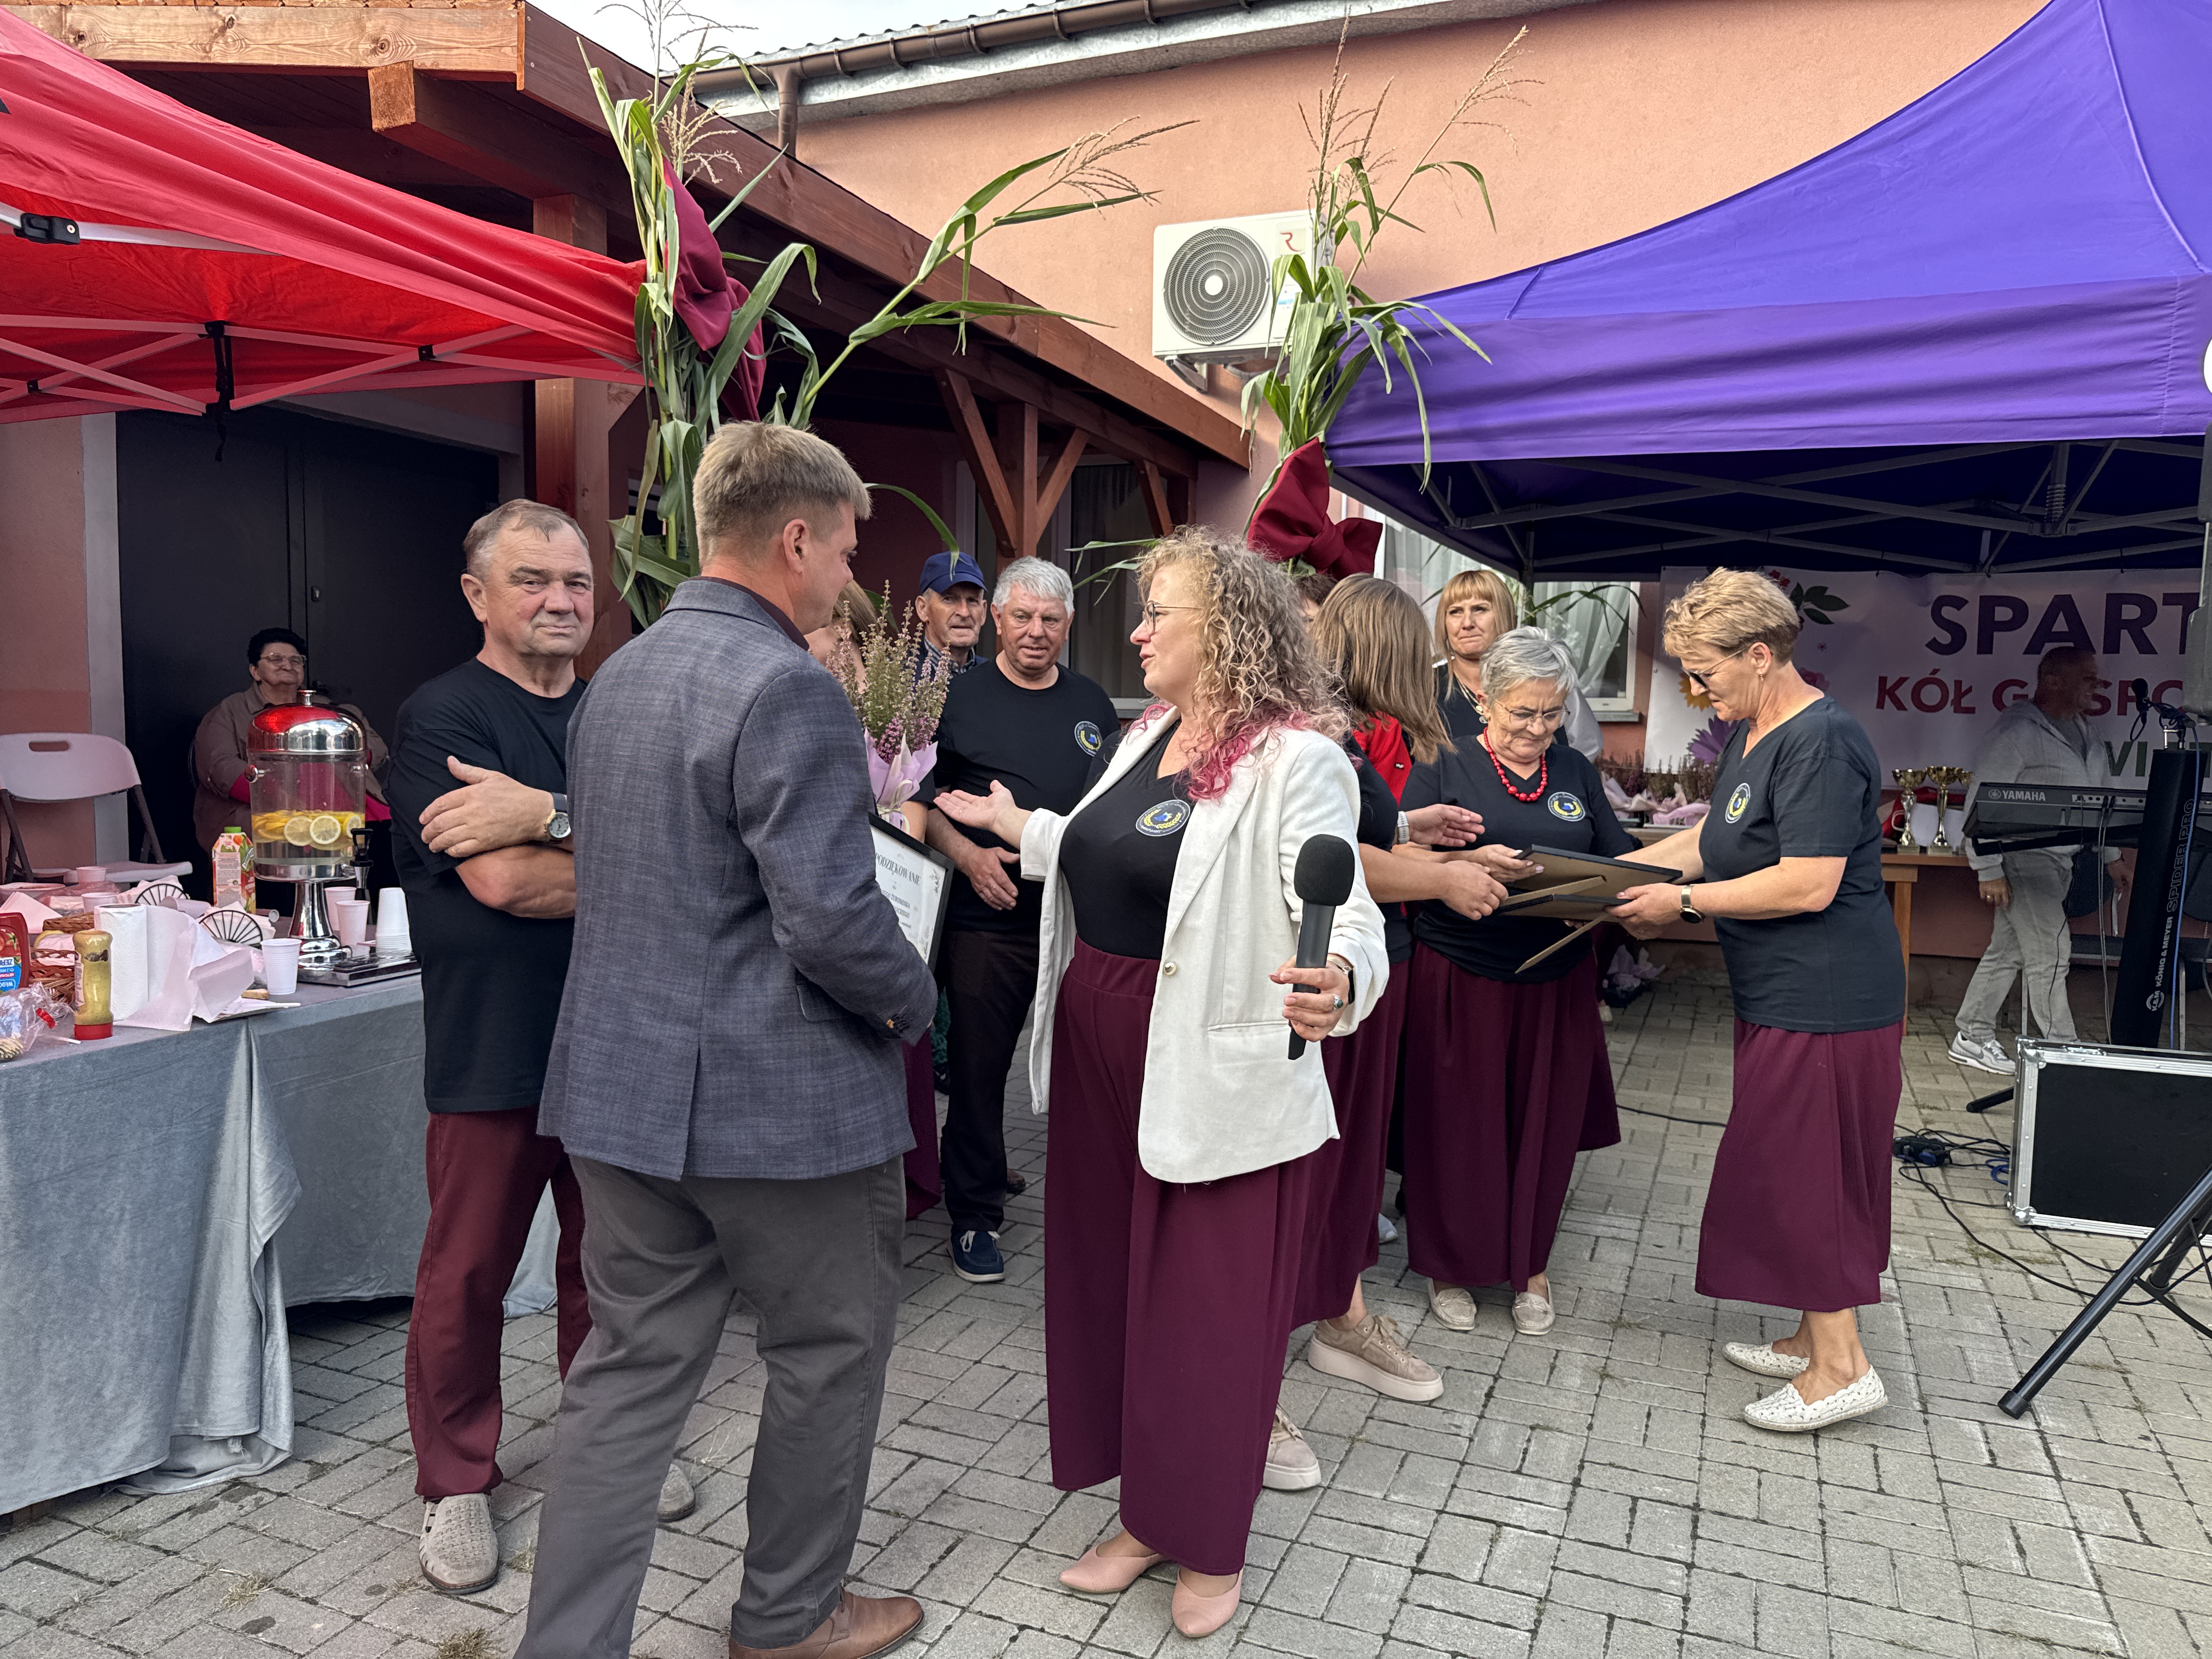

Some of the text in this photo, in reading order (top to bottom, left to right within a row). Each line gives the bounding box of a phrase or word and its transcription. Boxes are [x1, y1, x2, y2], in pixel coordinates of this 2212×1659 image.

[1876, 668, 1976, 714] KÓŁ
[2002, 789, 2046, 802] YAMAHA
[2179, 799, 2195, 840] PRO
[875, 852, 921, 886] PODZIĘKOWANIE
[2166, 843, 2189, 913] SPIDER
[2162, 916, 2174, 949] MEYER
[2155, 957, 2166, 987] KÖNIG
[2152, 990, 2160, 1011] K&M
